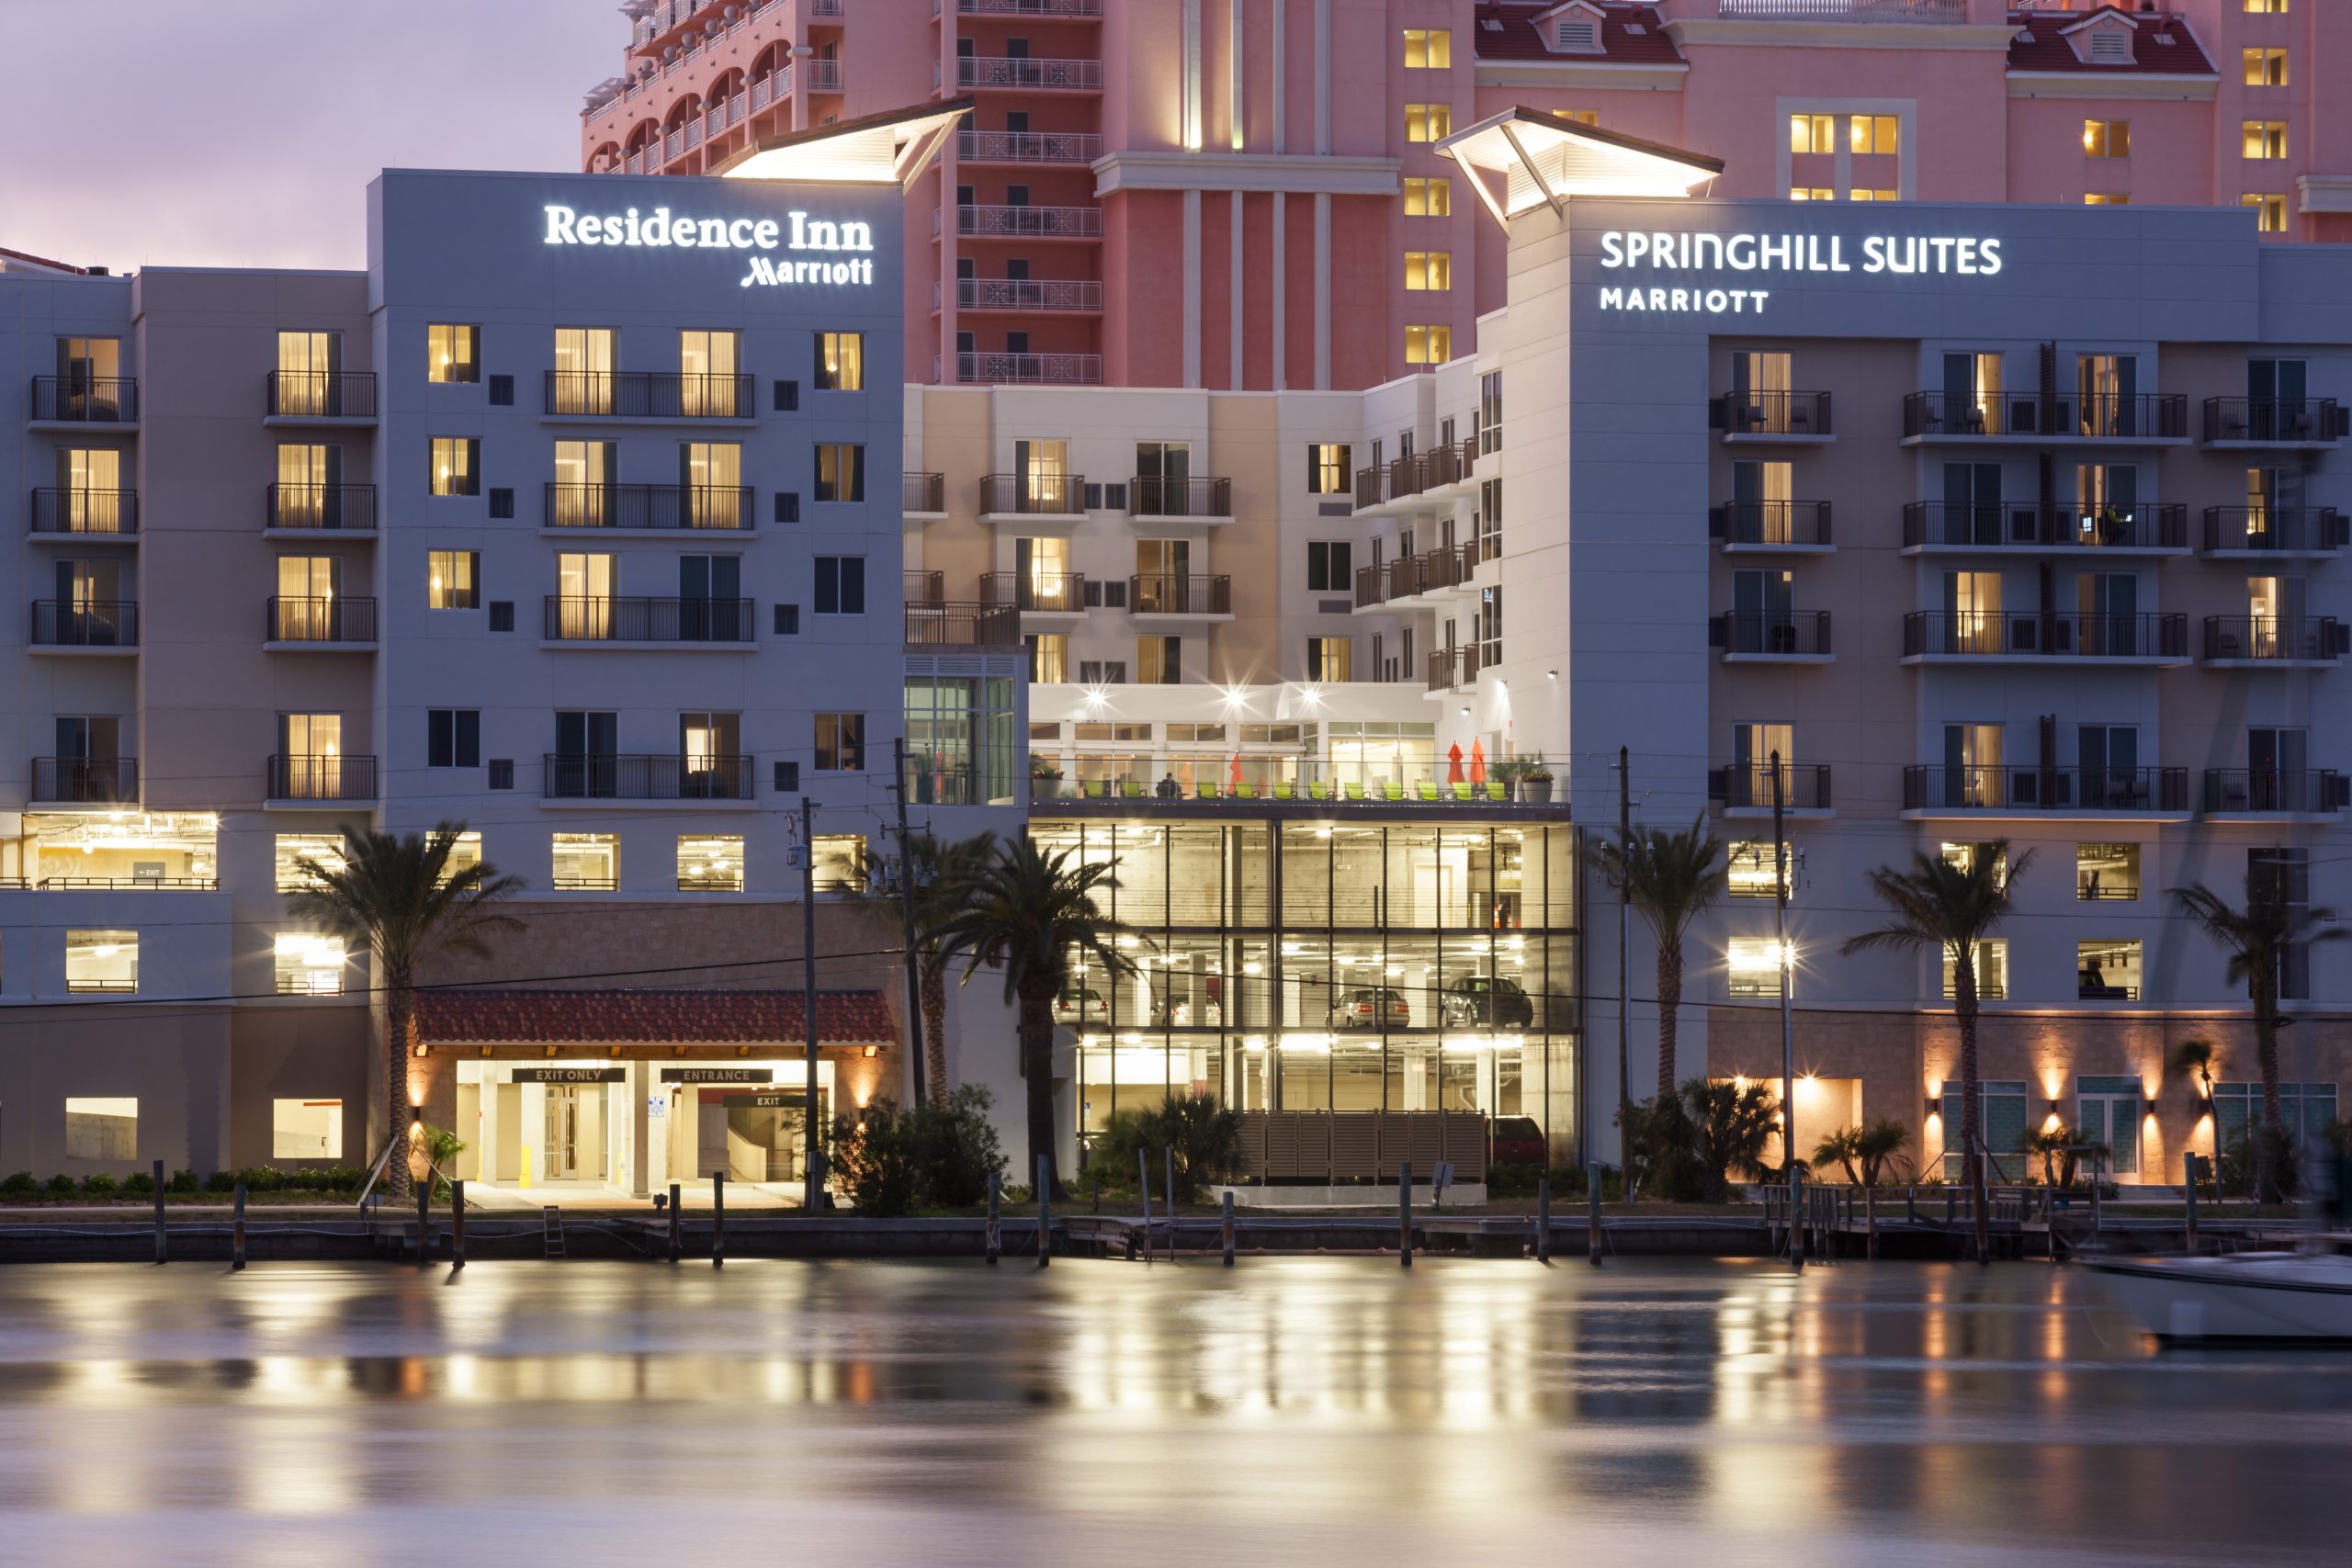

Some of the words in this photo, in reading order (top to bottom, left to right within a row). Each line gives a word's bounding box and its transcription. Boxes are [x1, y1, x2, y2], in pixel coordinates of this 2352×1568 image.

[544, 205, 779, 248] Residence
[788, 211, 874, 251] Inn
[1600, 231, 1850, 272] SPRINGHILL
[1862, 236, 2003, 275] SUITES
[741, 256, 873, 288] Marriott
[1600, 288, 1769, 313] MARRIOTT
[145, 868, 160, 876] EXIT
[536, 1070, 564, 1080] EXIT
[567, 1070, 602, 1080] ONLY
[684, 1070, 750, 1081] ENTRANCE
[757, 1097, 780, 1106] EXIT
